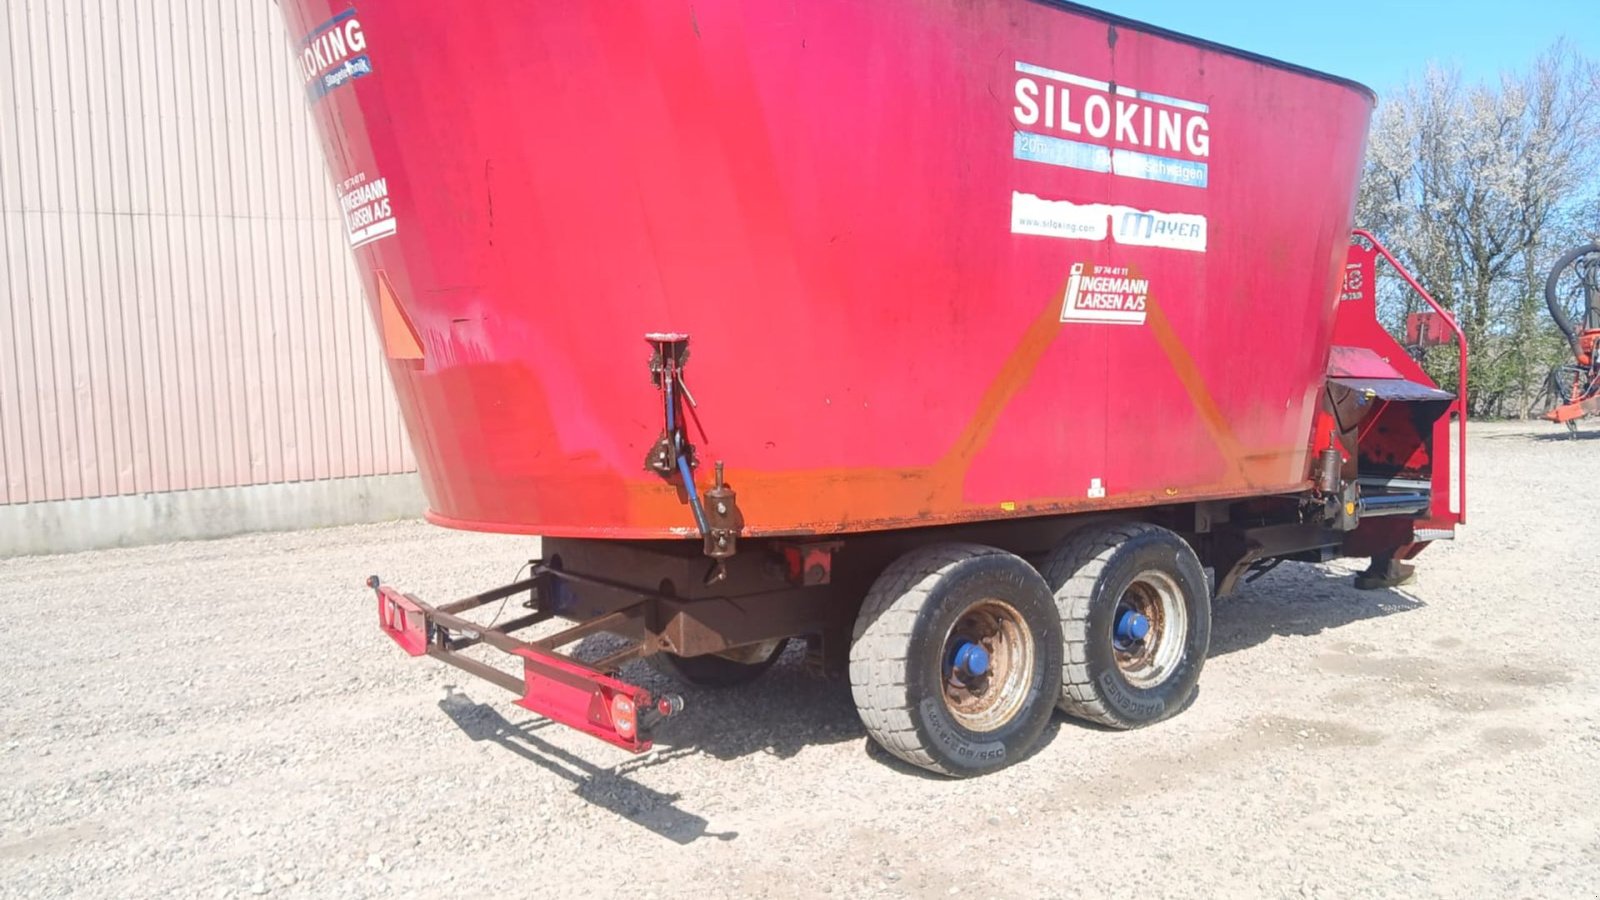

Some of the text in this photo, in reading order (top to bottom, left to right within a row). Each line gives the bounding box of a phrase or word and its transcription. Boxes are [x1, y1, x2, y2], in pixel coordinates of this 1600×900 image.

[1013, 77, 1210, 157] SILOKING
[373, 197, 392, 221] A/S
[1076, 292, 1147, 311] LARSEN A/S
